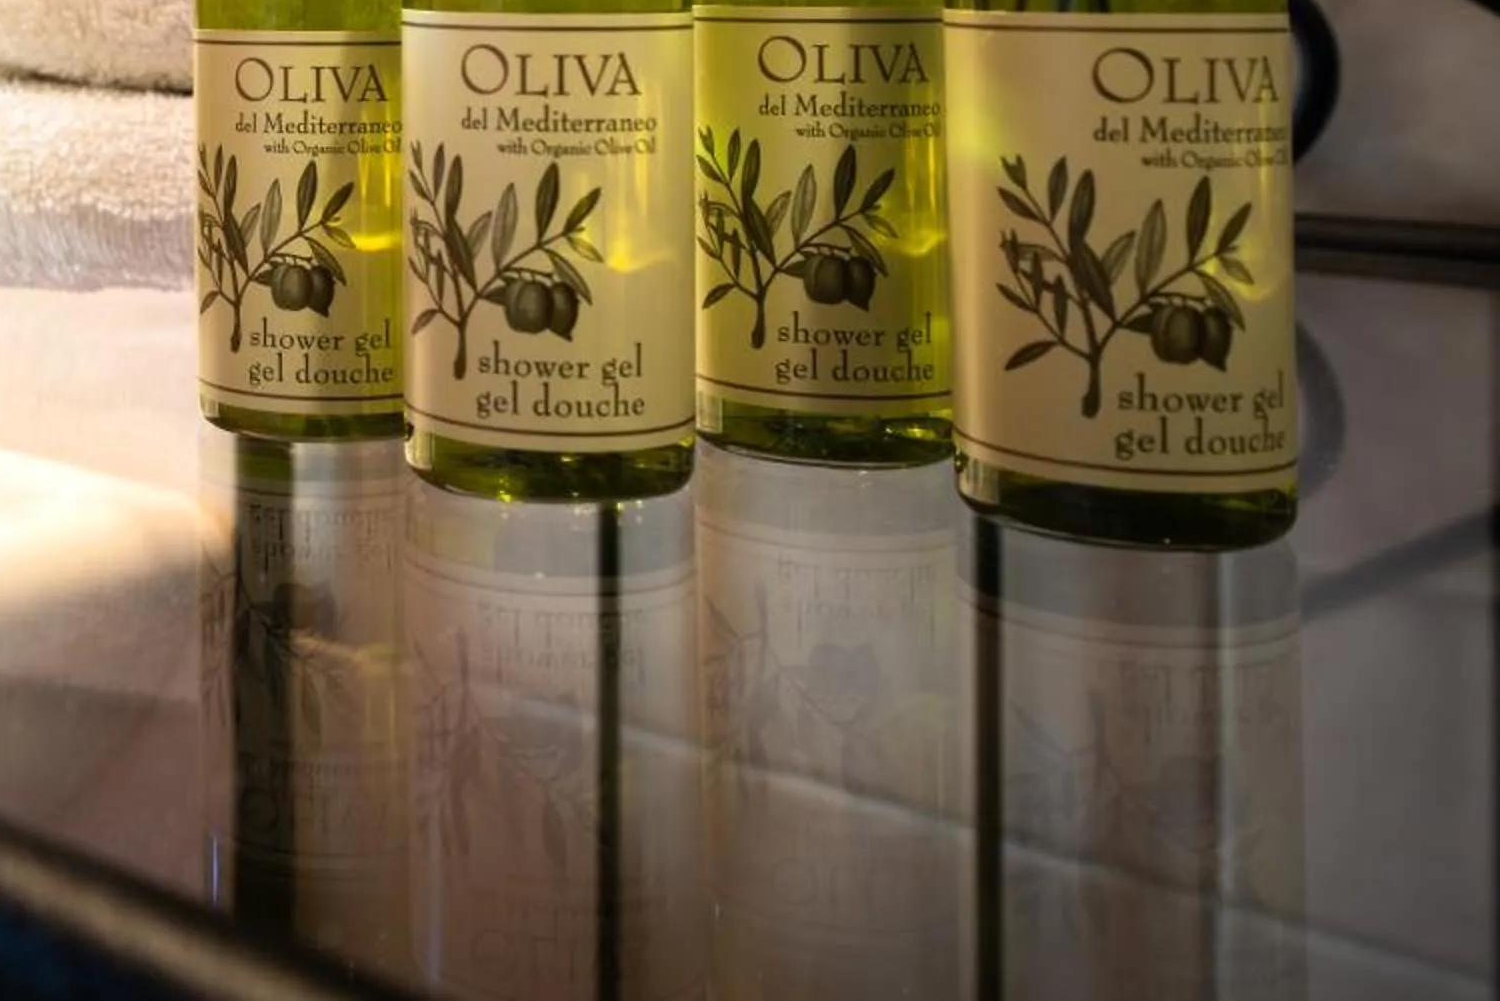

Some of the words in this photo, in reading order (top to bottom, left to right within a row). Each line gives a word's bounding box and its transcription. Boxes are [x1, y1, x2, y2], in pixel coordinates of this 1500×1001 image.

[461, 43, 642, 99] OLIVA
[758, 35, 929, 85] OLIVA
[1092, 47, 1280, 105] OLIVA
[234, 57, 389, 103] OLIVA
[235, 112, 257, 133] del
[263, 109, 404, 135] Mediterraneo
[461, 106, 487, 131] del
[495, 103, 658, 133] Mediterraneo
[758, 92, 786, 116] del
[794, 90, 942, 118] Mediterraneo
[263, 137, 290, 154] with
[496, 137, 527, 155] with
[795, 120, 826, 138] with
[1093, 115, 1129, 142] del
[249, 317, 344, 352] shower
[355, 318, 392, 358] gel
[777, 311, 885, 348] shower
[896, 312, 932, 354] gel
[248, 352, 284, 387] gel
[296, 353, 394, 385] douche
[477, 340, 591, 380] shower
[601, 343, 643, 383] gel
[774, 347, 819, 385] gel
[832, 349, 933, 383] douche
[476, 381, 518, 418] gel
[532, 382, 645, 418] douche
[1117, 372, 1242, 413] shower
[1252, 369, 1285, 420] gel
[1114, 416, 1168, 460] gel
[1184, 416, 1285, 456] douche
